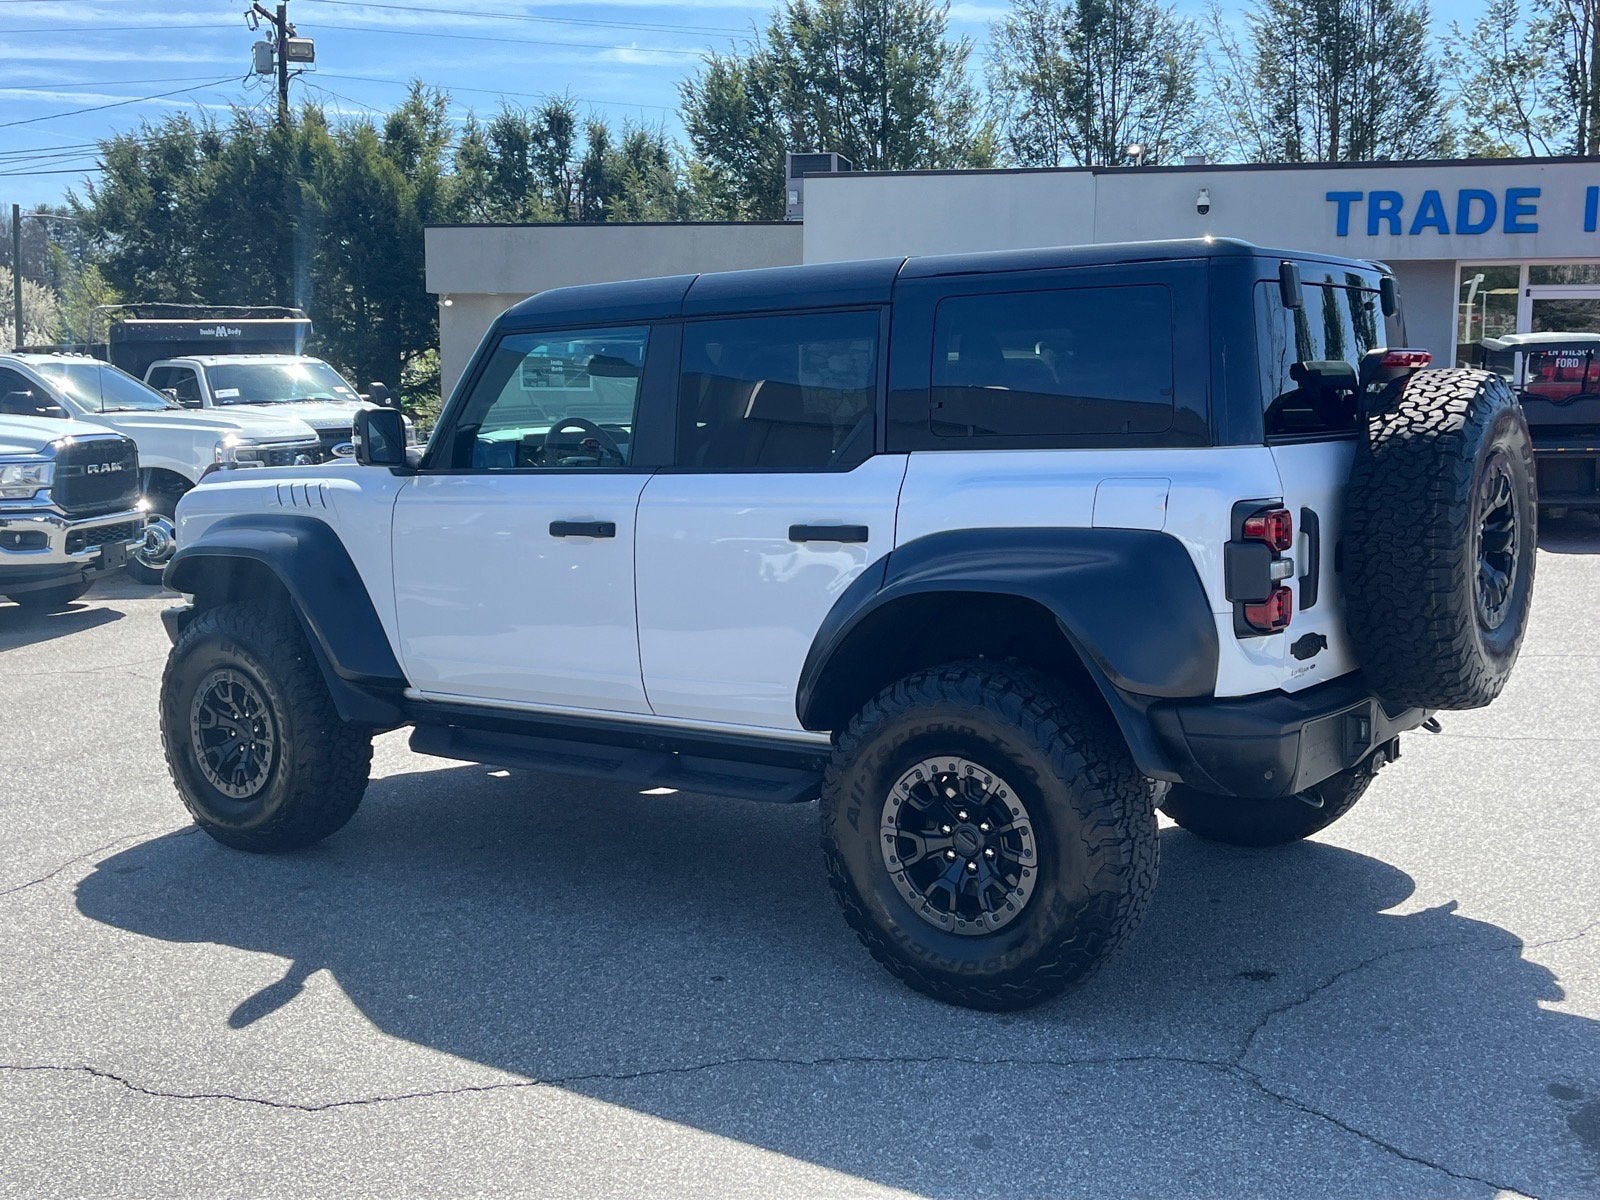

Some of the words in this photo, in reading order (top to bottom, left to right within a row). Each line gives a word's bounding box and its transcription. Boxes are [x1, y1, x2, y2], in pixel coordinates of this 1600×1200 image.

[1326, 187, 1541, 237] TRADE
[1555, 357, 1580, 368] FORD
[87, 462, 122, 474] RAM
